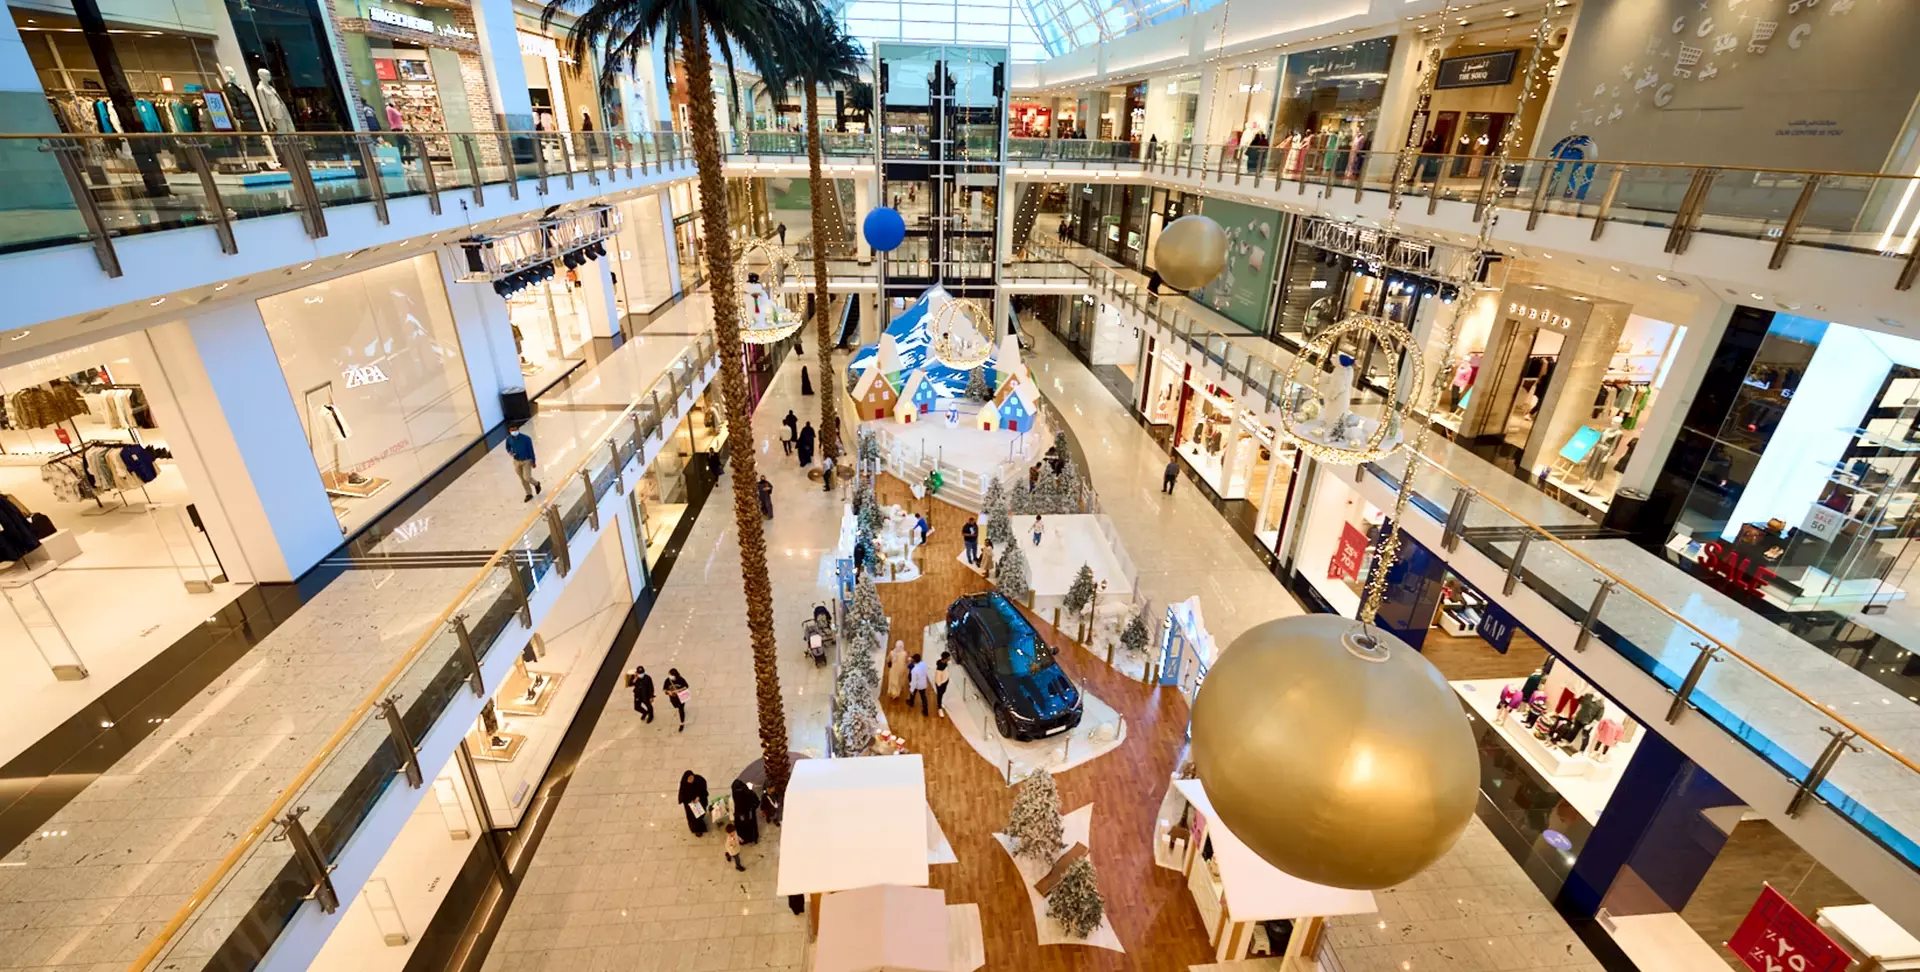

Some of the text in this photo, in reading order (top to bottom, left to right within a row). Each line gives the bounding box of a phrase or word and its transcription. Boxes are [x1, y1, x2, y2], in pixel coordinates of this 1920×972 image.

[1458, 71, 1488, 81] THE SOUQ
[342, 365, 389, 389] ZARA
[1810, 520, 1825, 532] 50
[1698, 541, 1777, 598] SALE
[1483, 614, 1506, 641] GAP
